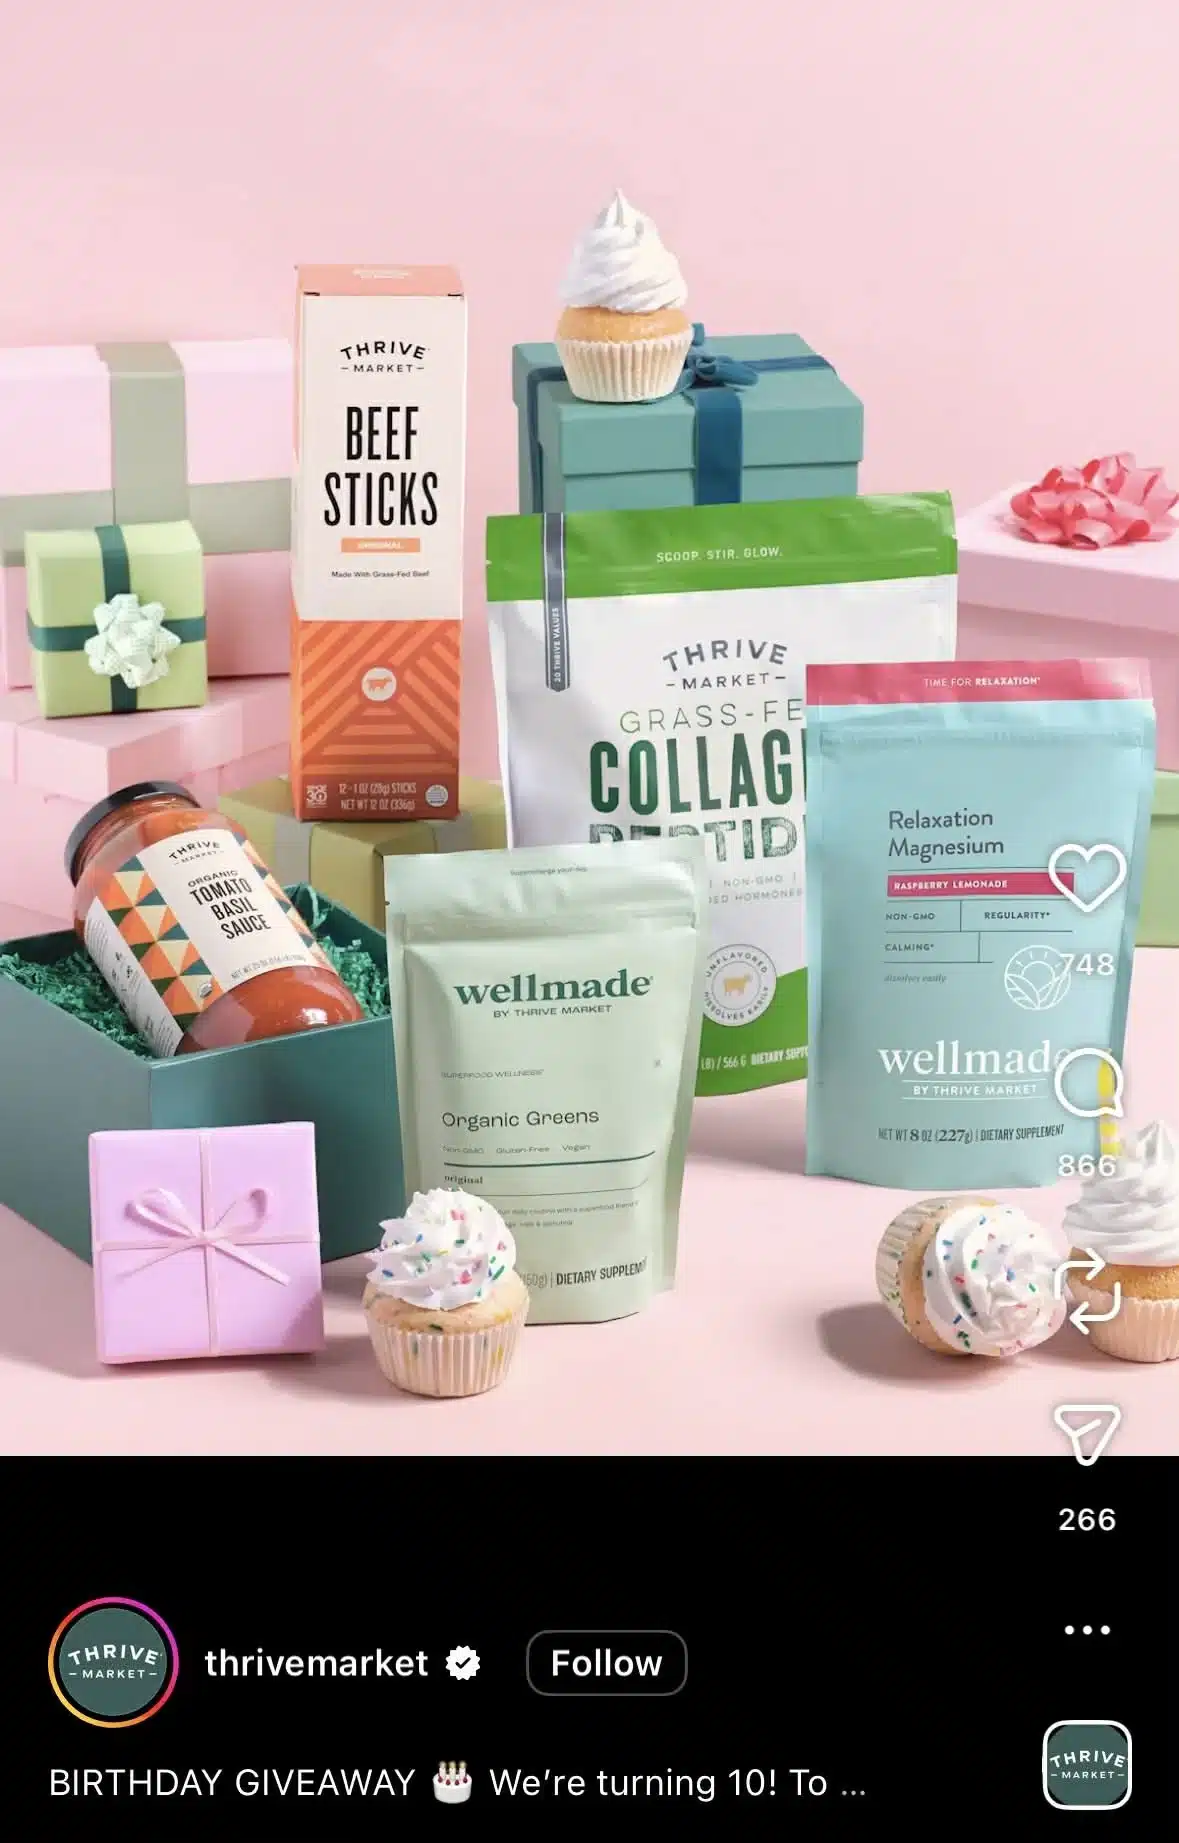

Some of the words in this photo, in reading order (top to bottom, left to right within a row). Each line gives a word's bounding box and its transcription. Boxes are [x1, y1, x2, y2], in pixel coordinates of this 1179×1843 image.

[340, 341, 427, 360] THRIVE
[353, 364, 414, 373] MARKET
[346, 406, 419, 460] BEEF
[324, 471, 438, 526] STICKS
[656, 551, 702, 563] SCOOP.
[706, 548, 739, 561] STIR.
[743, 546, 783, 559] GLOW.
[331, 570, 352, 578] Made
[354, 570, 371, 578] With
[372, 570, 411, 578] Grass-Fed
[412, 569, 430, 577] Beef
[551, 607, 561, 639] VALUES
[662, 639, 788, 672] THRIVE
[682, 672, 770, 690] MARKET
[924, 677, 947, 687] TIME
[951, 677, 972, 687] FOR
[589, 728, 807, 816] COLLAG
[338, 783, 348, 793] 12
[358, 783, 369, 793] OZ
[391, 782, 417, 794] STICKS
[340, 799, 355, 810] NET
[357, 799, 368, 811] WT
[370, 799, 378, 811] 12
[379, 799, 389, 811] OZ
[888, 807, 994, 830] Relaxation
[168, 839, 221, 861] THRIVE
[180, 850, 217, 864] MARKET
[888, 835, 1004, 863] Magnesium
[187, 869, 239, 888] ORGANIC
[723, 874, 783, 887] NON-GMO
[893, 880, 949, 890] RASPBERRY
[952, 879, 1008, 889] LEMONADE
[189, 877, 253, 906] TOMATO
[210, 896, 258, 920] BASIL
[885, 912, 936, 921] NON-GMO
[220, 914, 272, 940] SAUCE
[705, 951, 769, 979] UNFLAVORED
[453, 968, 652, 1005] wellmade
[493, 1009, 509, 1019] BY
[513, 1006, 558, 1017] THRIVE
[561, 1004, 613, 1015] MARKET
[723, 1055, 740, 1069] 566
[740, 1055, 746, 1068] G
[750, 1049, 784, 1066] DIETARY
[913, 1086, 929, 1096] BY
[932, 1085, 980, 1096] THRIVE
[984, 1084, 1037, 1095] MARKET
[442, 1111, 520, 1132] Organic
[526, 1108, 600, 1126] Greens
[878, 1127, 893, 1140] NET
[895, 1128, 908, 1141] WT
[909, 1129, 920, 1142] 8
[921, 1129, 933, 1142] OZ
[935, 1129, 973, 1144] (227g)
[980, 1128, 1014, 1142] DIETARY
[1015, 1123, 1065, 1140] SUPPLEMENT
[444, 1175, 484, 1185] original
[556, 1268, 598, 1286] DIETARY
